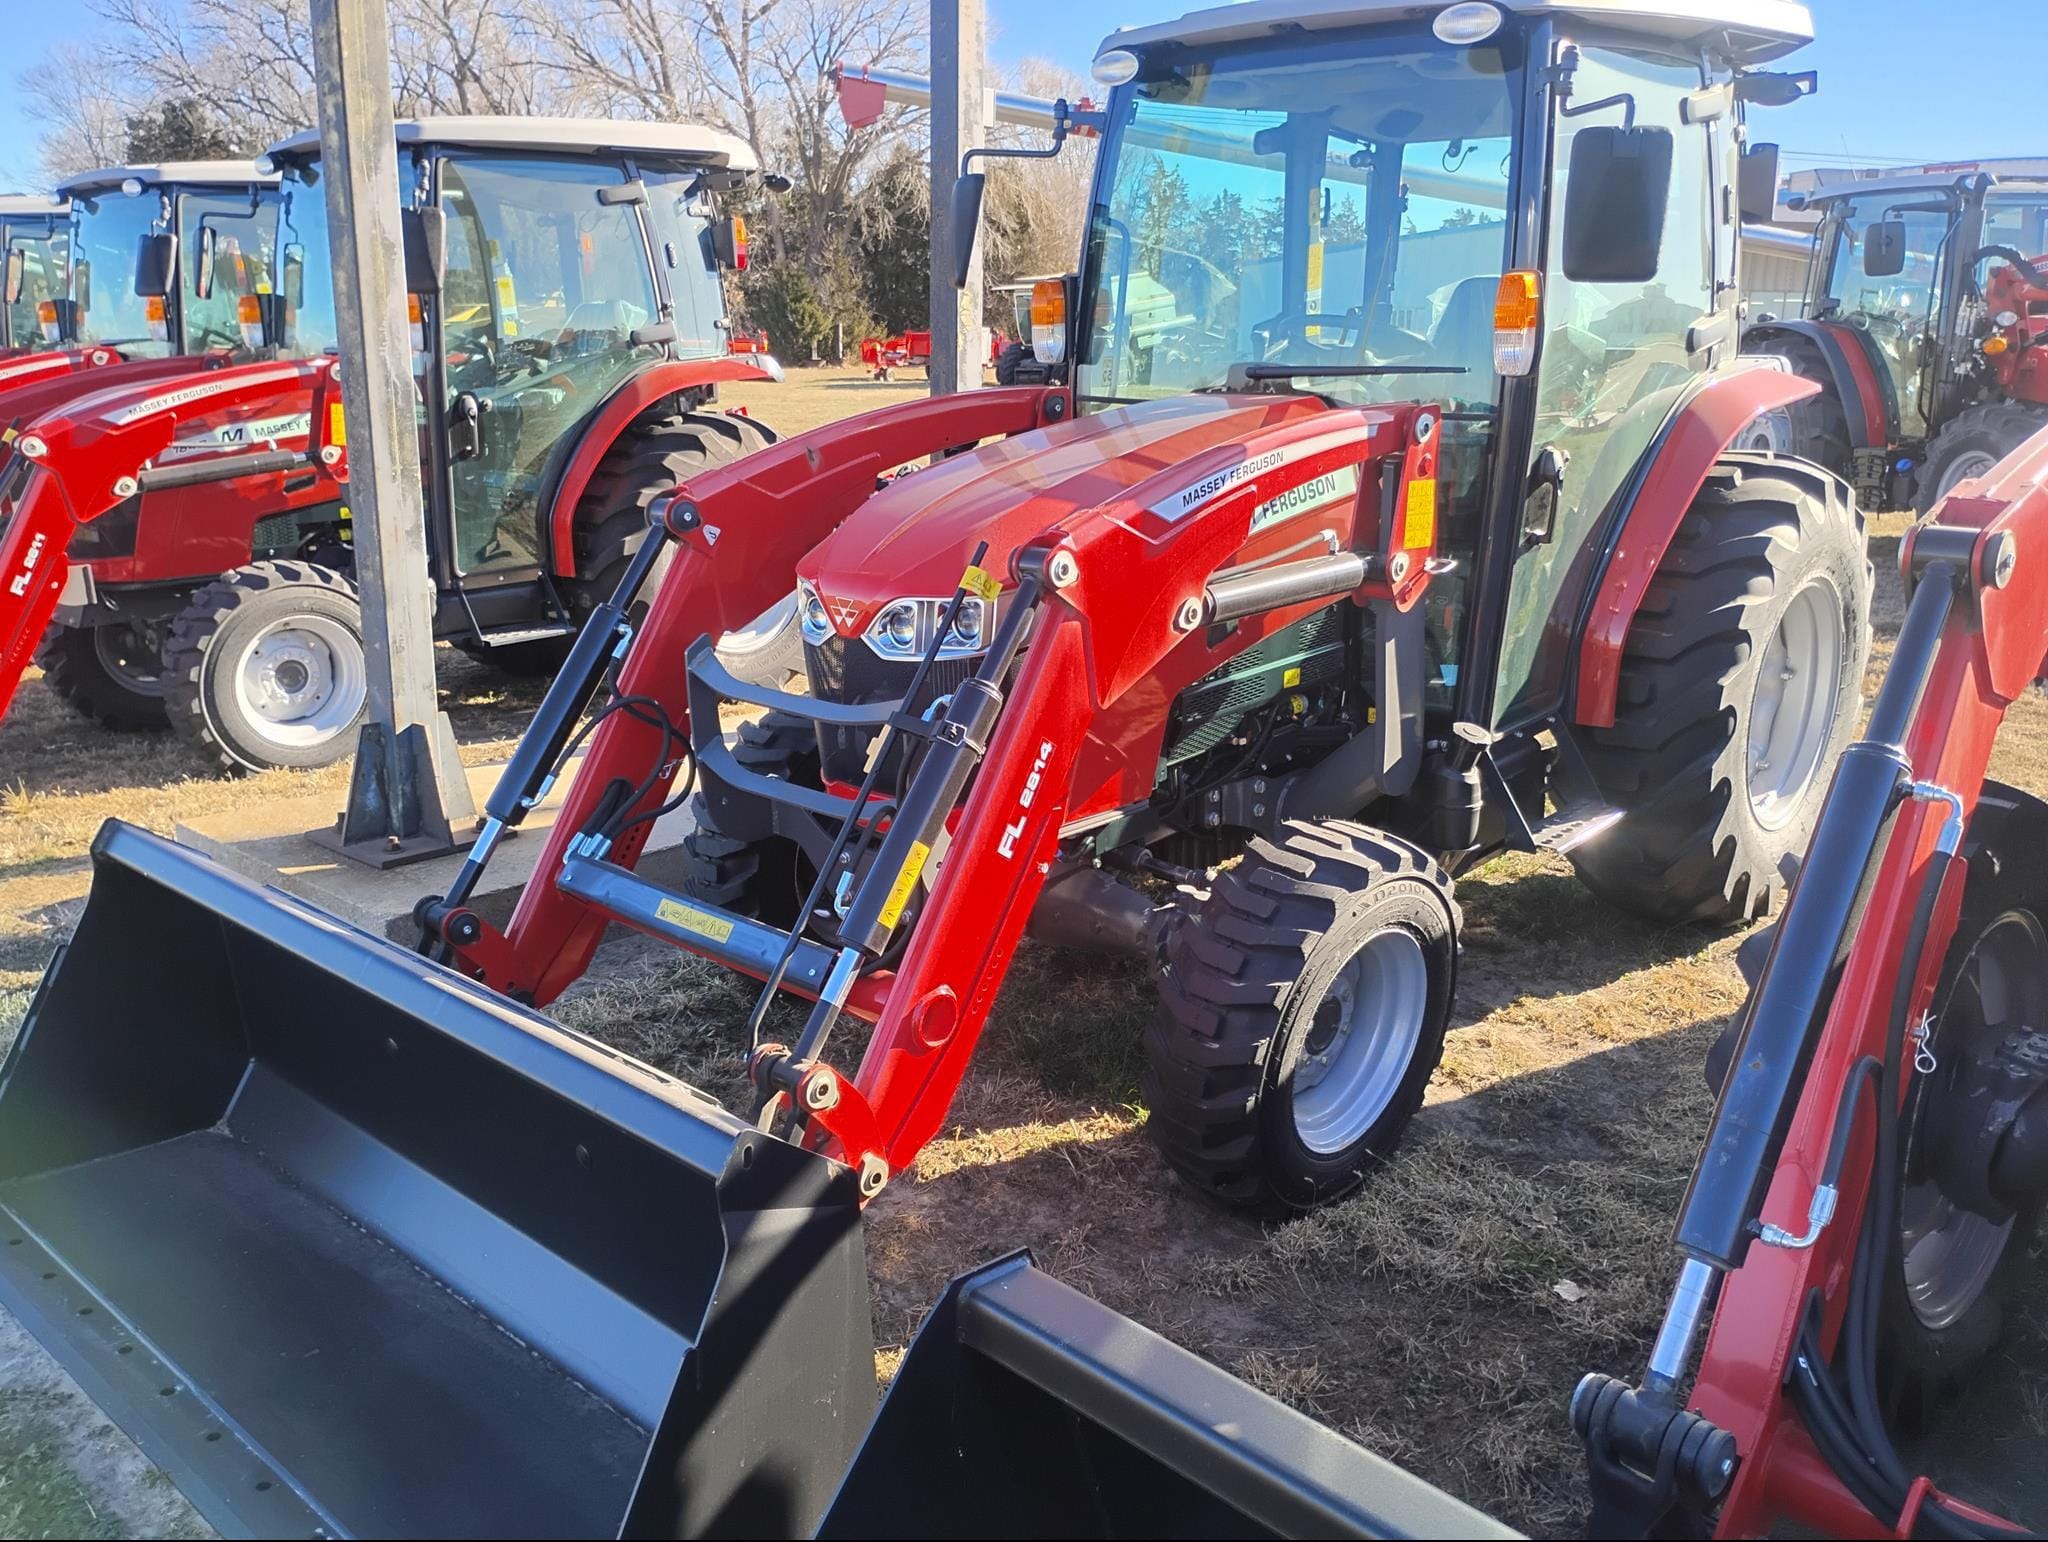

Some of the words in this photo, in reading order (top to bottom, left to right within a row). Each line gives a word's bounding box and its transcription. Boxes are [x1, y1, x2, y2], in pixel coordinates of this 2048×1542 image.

[128, 399, 168, 416] MASSEY
[171, 383, 223, 403] FERGUSON
[255, 420, 301, 437] MASSEY
[1182, 474, 1227, 508] MASSEY
[1229, 450, 1284, 482] FERGUSON
[1262, 474, 1336, 519] FERGUSON
[9, 570, 32, 596] FL
[997, 816, 1027, 859] FL
[1020, 742, 1053, 808] 2814
